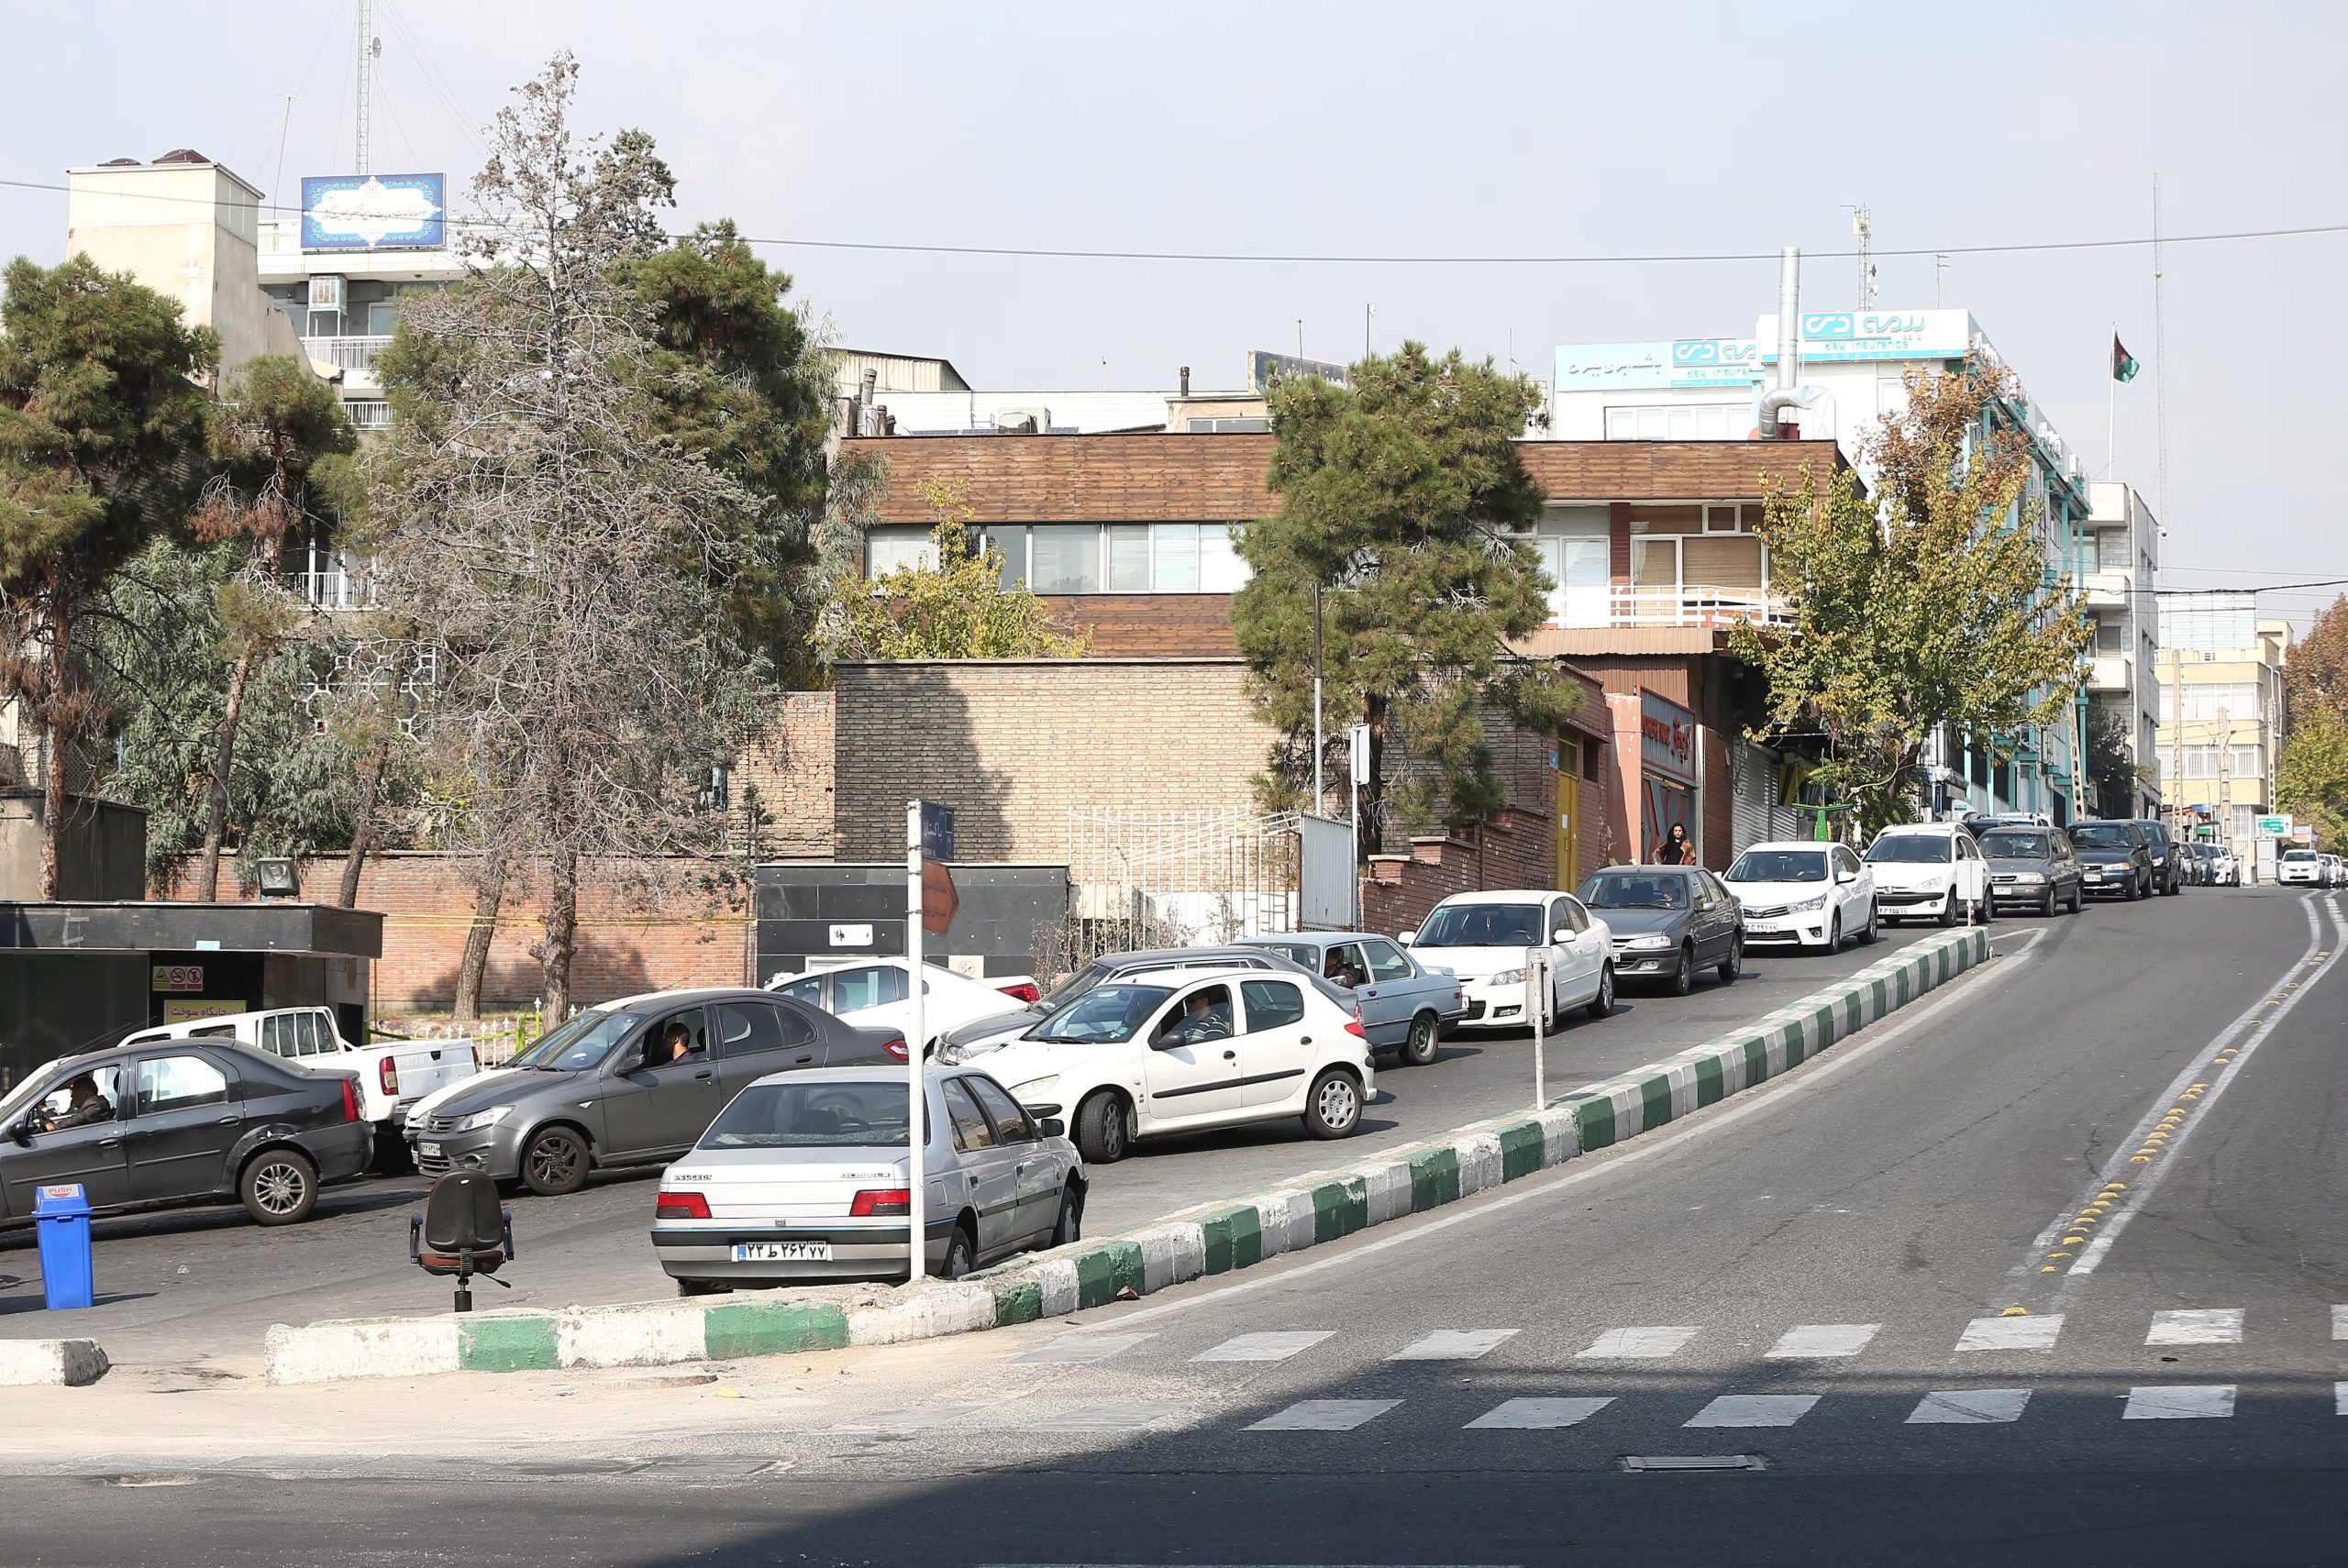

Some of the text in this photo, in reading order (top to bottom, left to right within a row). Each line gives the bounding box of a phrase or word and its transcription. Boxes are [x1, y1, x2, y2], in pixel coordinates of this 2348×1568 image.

[1824, 339, 1909, 351] day insurance
[1687, 367, 1749, 379] day insura
[171, 1007, 199, 1019] سوخت
[201, 1006, 227, 1017] جایگاه
[747, 1243, 764, 1258] ۲۳
[768, 1243, 778, 1258] ط
[809, 1246, 825, 1259] ۷۷
